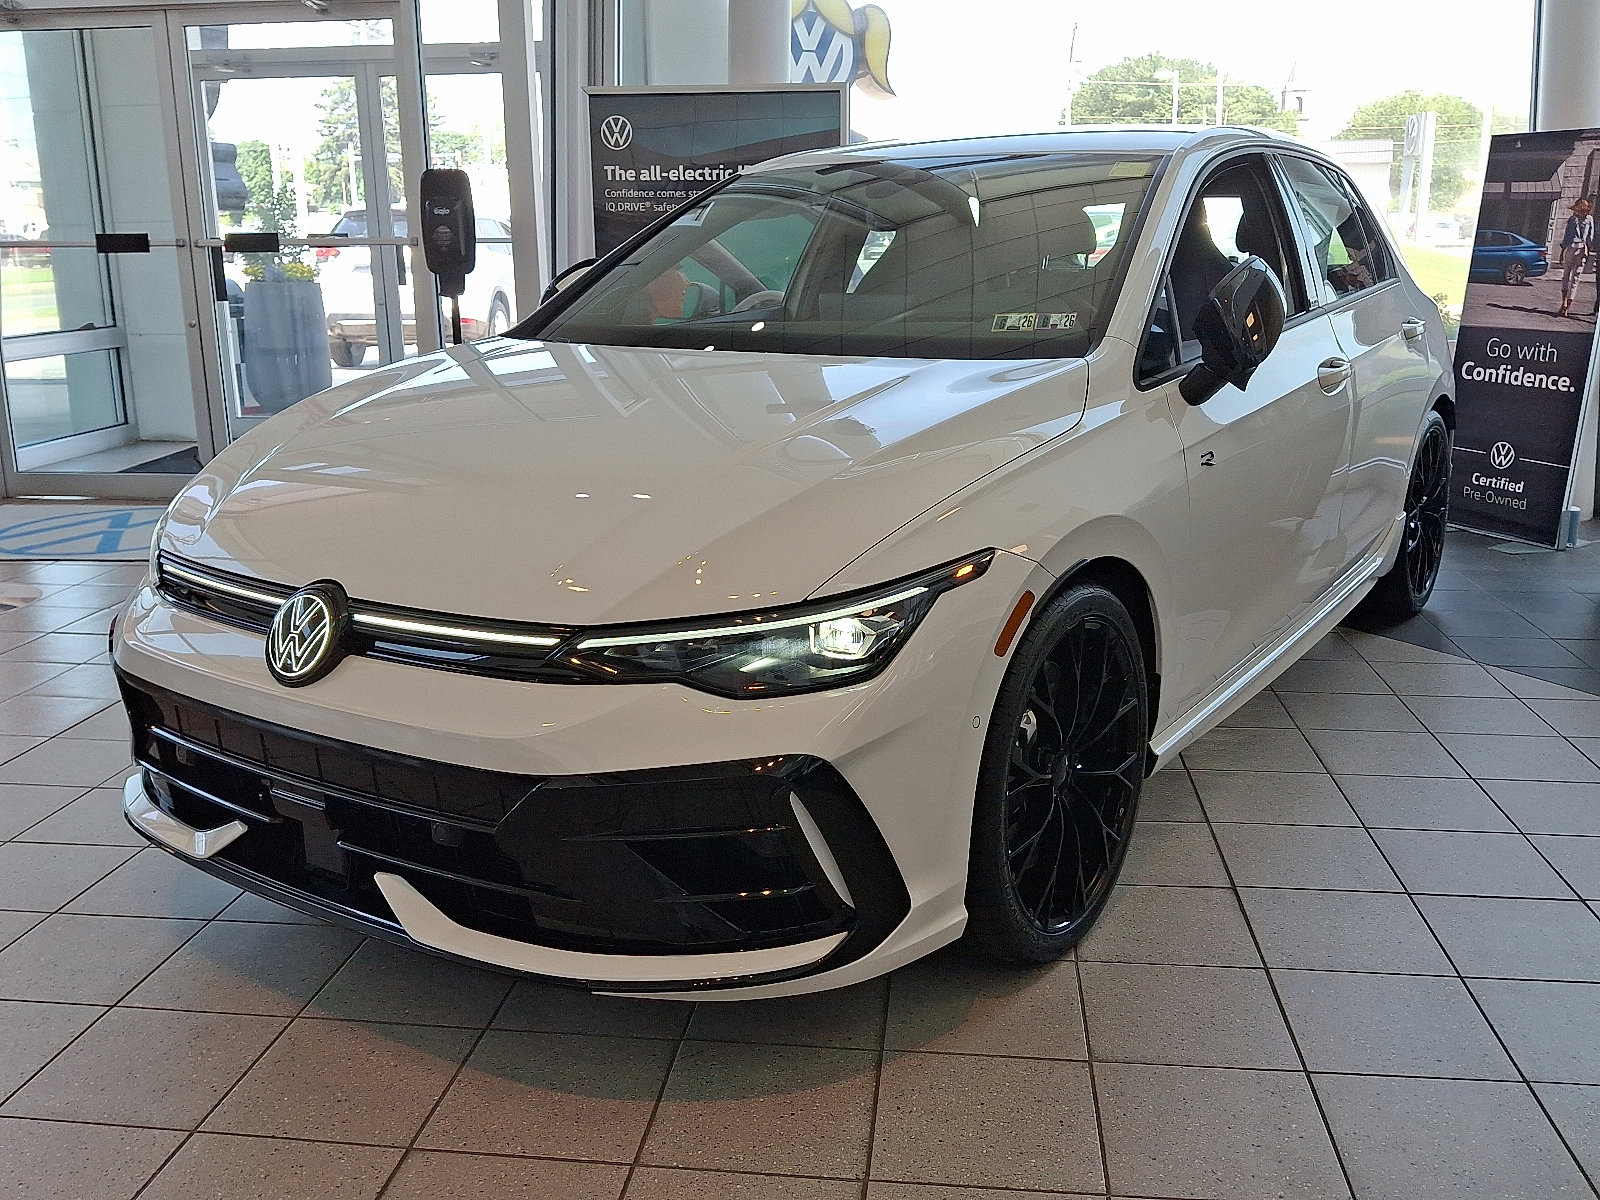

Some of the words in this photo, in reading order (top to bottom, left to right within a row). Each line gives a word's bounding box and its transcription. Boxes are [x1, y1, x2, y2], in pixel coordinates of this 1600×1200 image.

[600, 115, 633, 150] VW
[603, 165, 636, 181] The
[639, 164, 734, 181] all-electric
[604, 188, 655, 198] Confidence
[656, 190, 686, 198] comes
[653, 201, 678, 212] safet
[1021, 315, 1034, 328] 26
[1063, 314, 1076, 328] 26
[1486, 337, 1512, 359] Go
[1517, 342, 1558, 363] with
[1461, 361, 1576, 393] Confidence.
[1490, 441, 1515, 470] VW
[1471, 472, 1525, 493] Certified
[1463, 486, 1528, 510] Pre-Owned
[269, 595, 330, 676] VW
